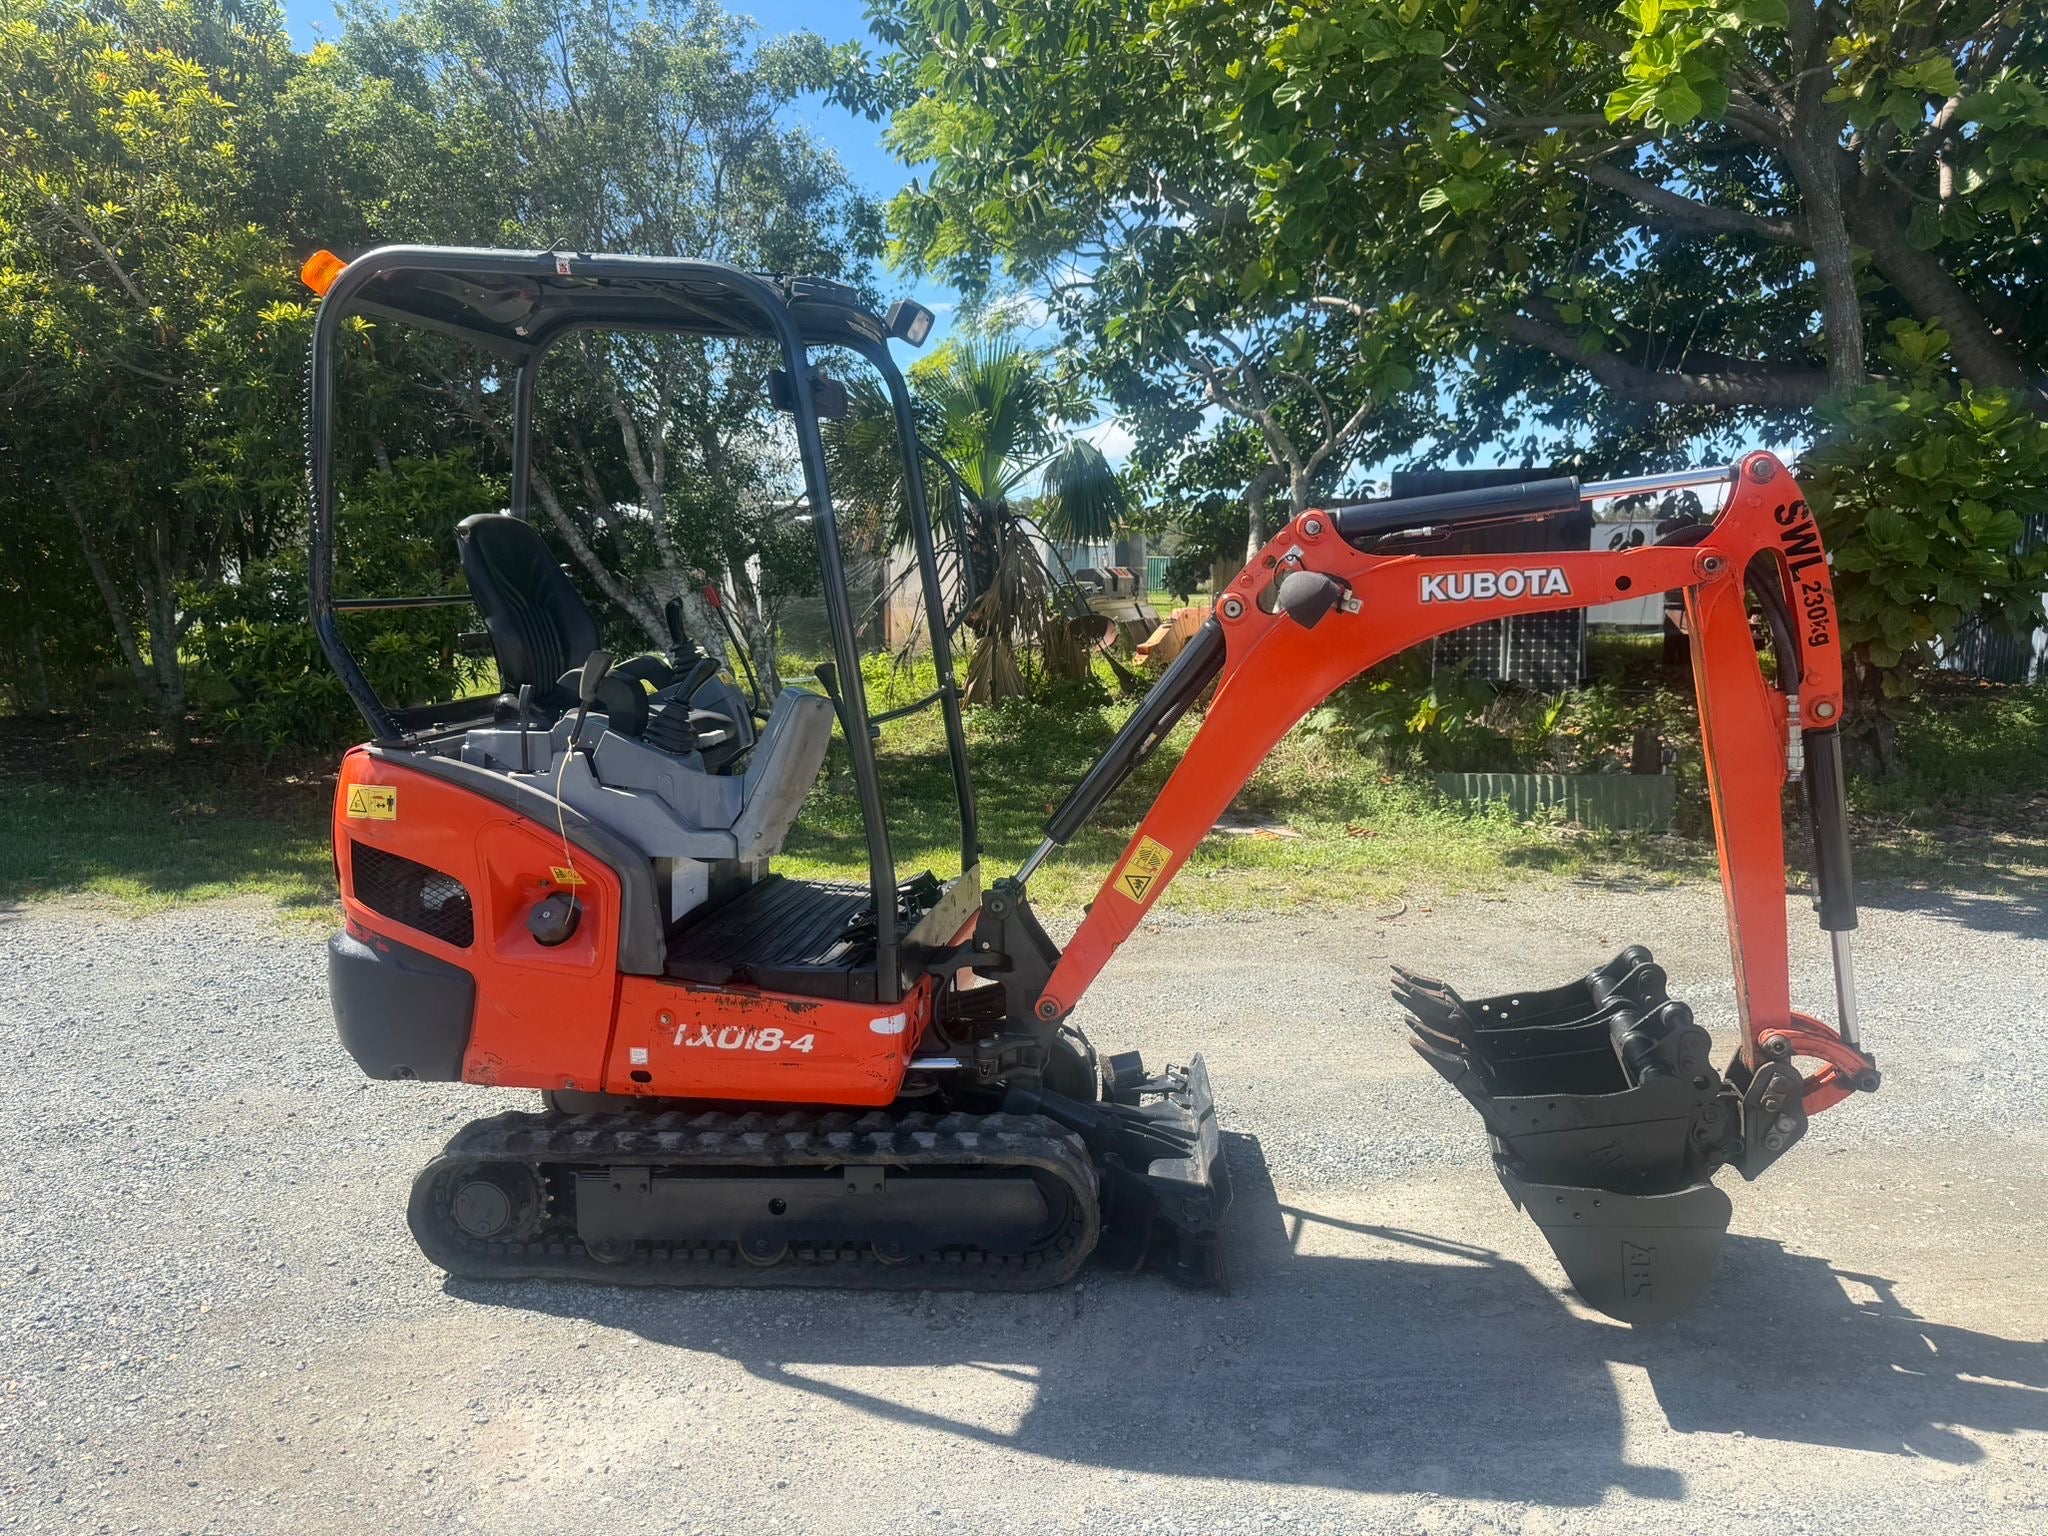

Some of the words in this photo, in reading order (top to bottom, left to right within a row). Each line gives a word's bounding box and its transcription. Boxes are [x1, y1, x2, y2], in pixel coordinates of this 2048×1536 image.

[1420, 567, 1571, 602] KUBOTA
[1774, 500, 1824, 582] SWL
[1801, 580, 1830, 647] 230kg
